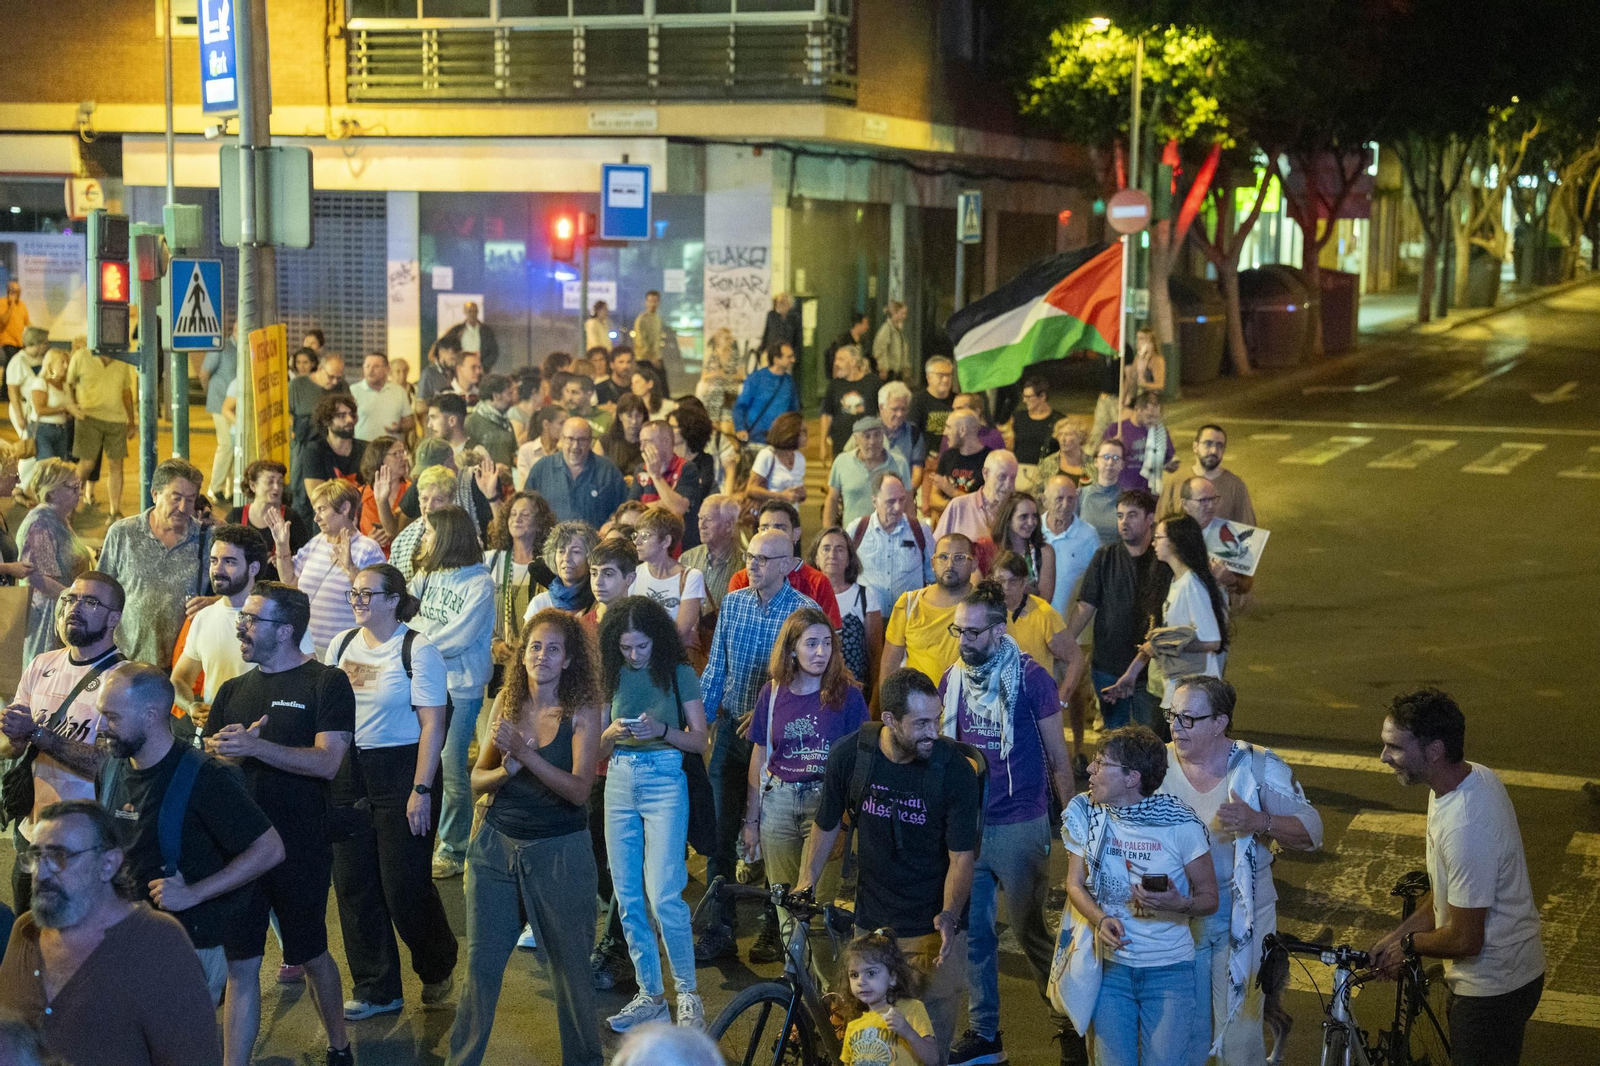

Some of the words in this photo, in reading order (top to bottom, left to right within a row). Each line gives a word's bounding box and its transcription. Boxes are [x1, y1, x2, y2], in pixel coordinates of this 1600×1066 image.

[1223, 559, 1251, 572] ENOCIDIO
[271, 699, 306, 710] palestina
[977, 729, 1001, 738] PALESTI
[987, 741, 1001, 750] BD
[800, 752, 829, 761] PALESTINA
[805, 764, 826, 774] BDS
[1112, 837, 1123, 848] UNA
[1124, 841, 1162, 852] PALESTINA
[1106, 847, 1122, 858] LIBRE
[1123, 849, 1127, 859] Y
[1128, 851, 1138, 860] EN
[1138, 852, 1151, 861] PAZ
